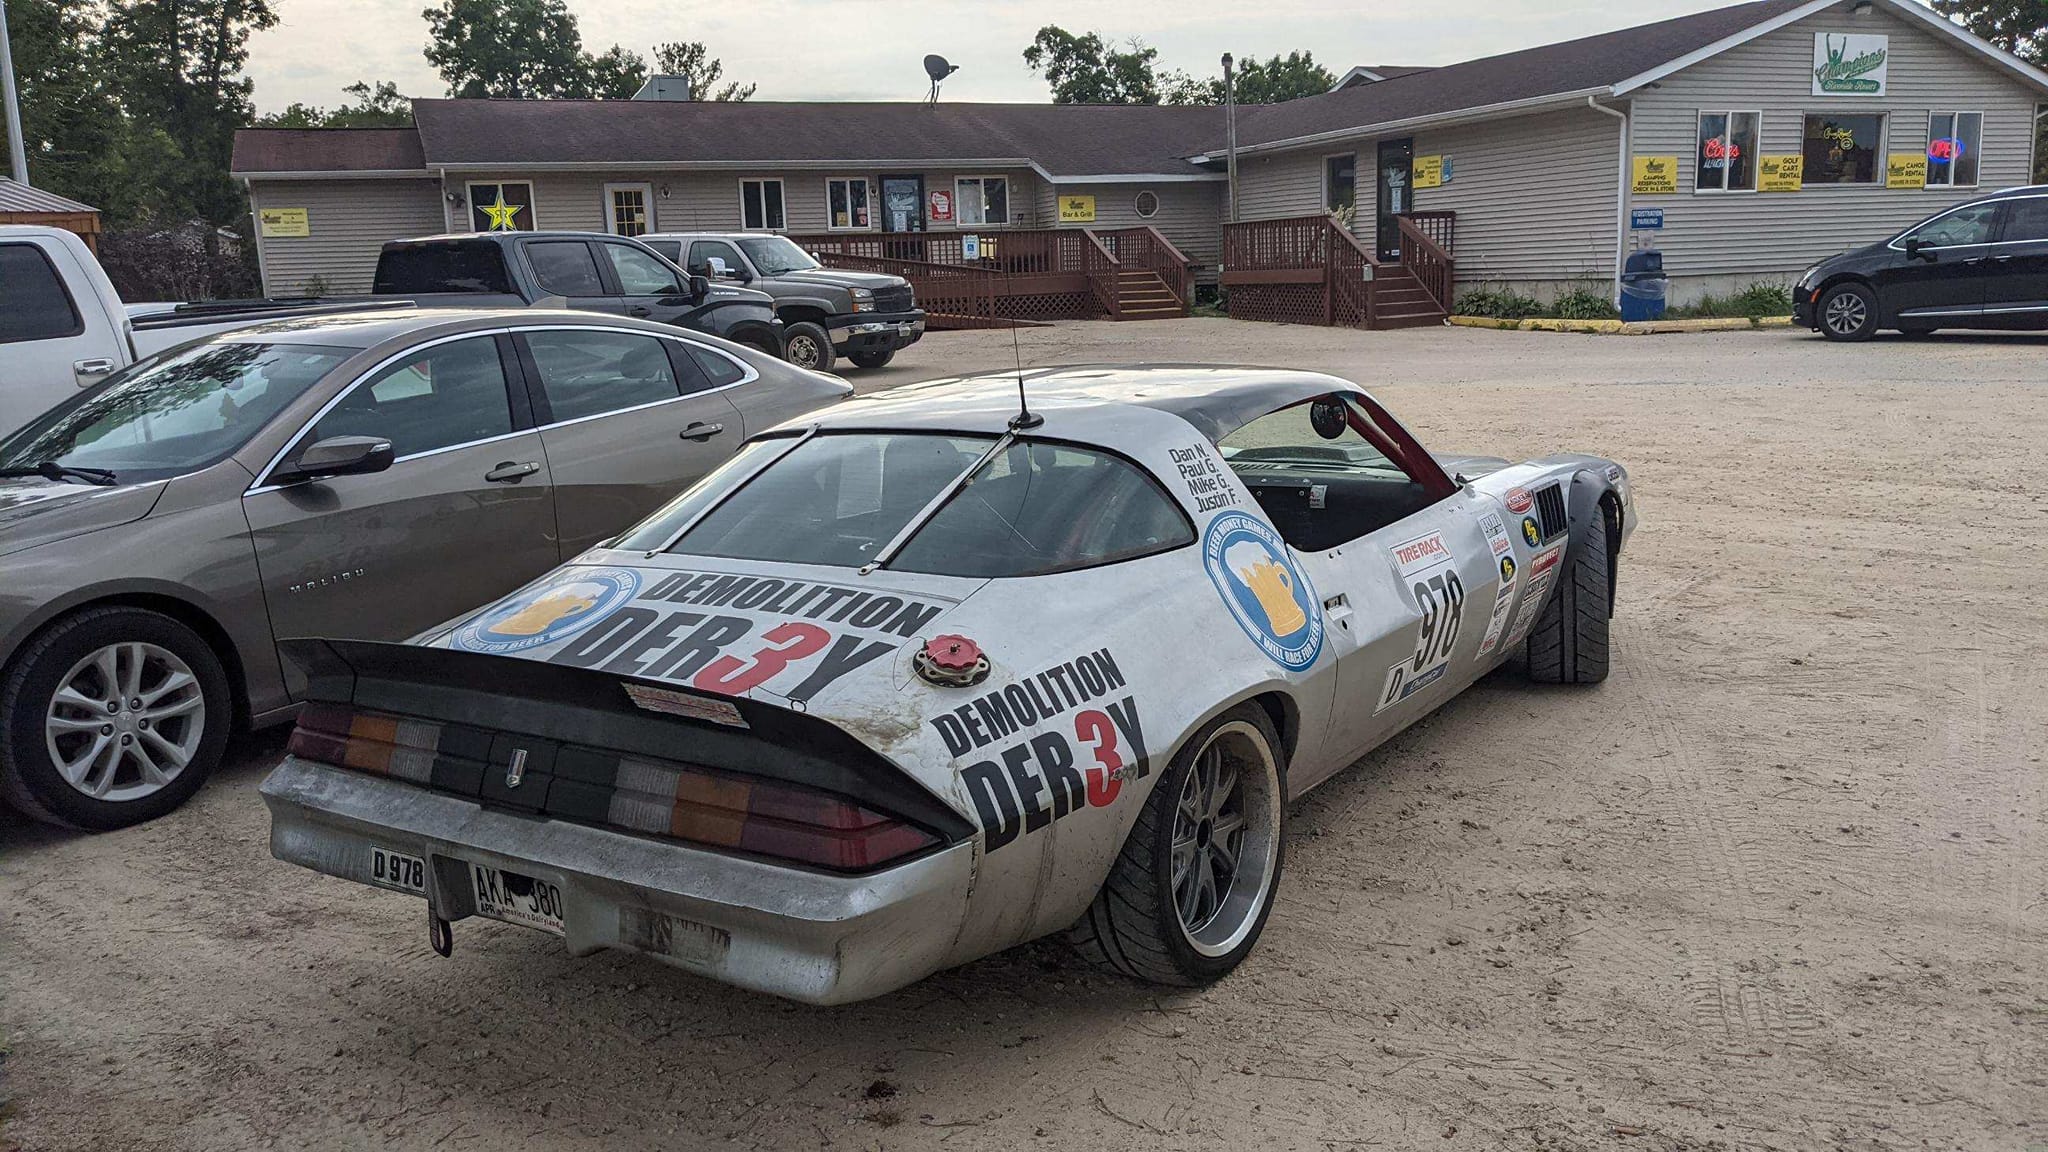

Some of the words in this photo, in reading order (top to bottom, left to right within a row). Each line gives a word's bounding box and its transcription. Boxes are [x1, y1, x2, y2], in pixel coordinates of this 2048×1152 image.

[1168, 447, 1197, 463] Dan
[1194, 443, 1209, 458] N.
[1177, 460, 1206, 479] Paul
[1205, 458, 1219, 473] G.
[1187, 477, 1217, 496] Mike
[1216, 473, 1230, 489] G.
[1195, 491, 1230, 513] Justin
[1228, 488, 1241, 505] F.
[1217, 518, 1241, 537] MONEY
[289, 568, 364, 592] MALIBU
[637, 572, 943, 638] DEMOLITION
[1413, 569, 1464, 673] 978
[547, 606, 899, 700] DER3Y
[1301, 643, 1313, 660] FOR
[1384, 667, 1403, 704] D
[929, 647, 1126, 759] DEMOLITION
[960, 695, 1150, 855] DER3Y
[374, 850, 385, 878] D
[390, 854, 424, 888] 978
[475, 866, 515, 908] AKA
[480, 902, 496, 914] APR
